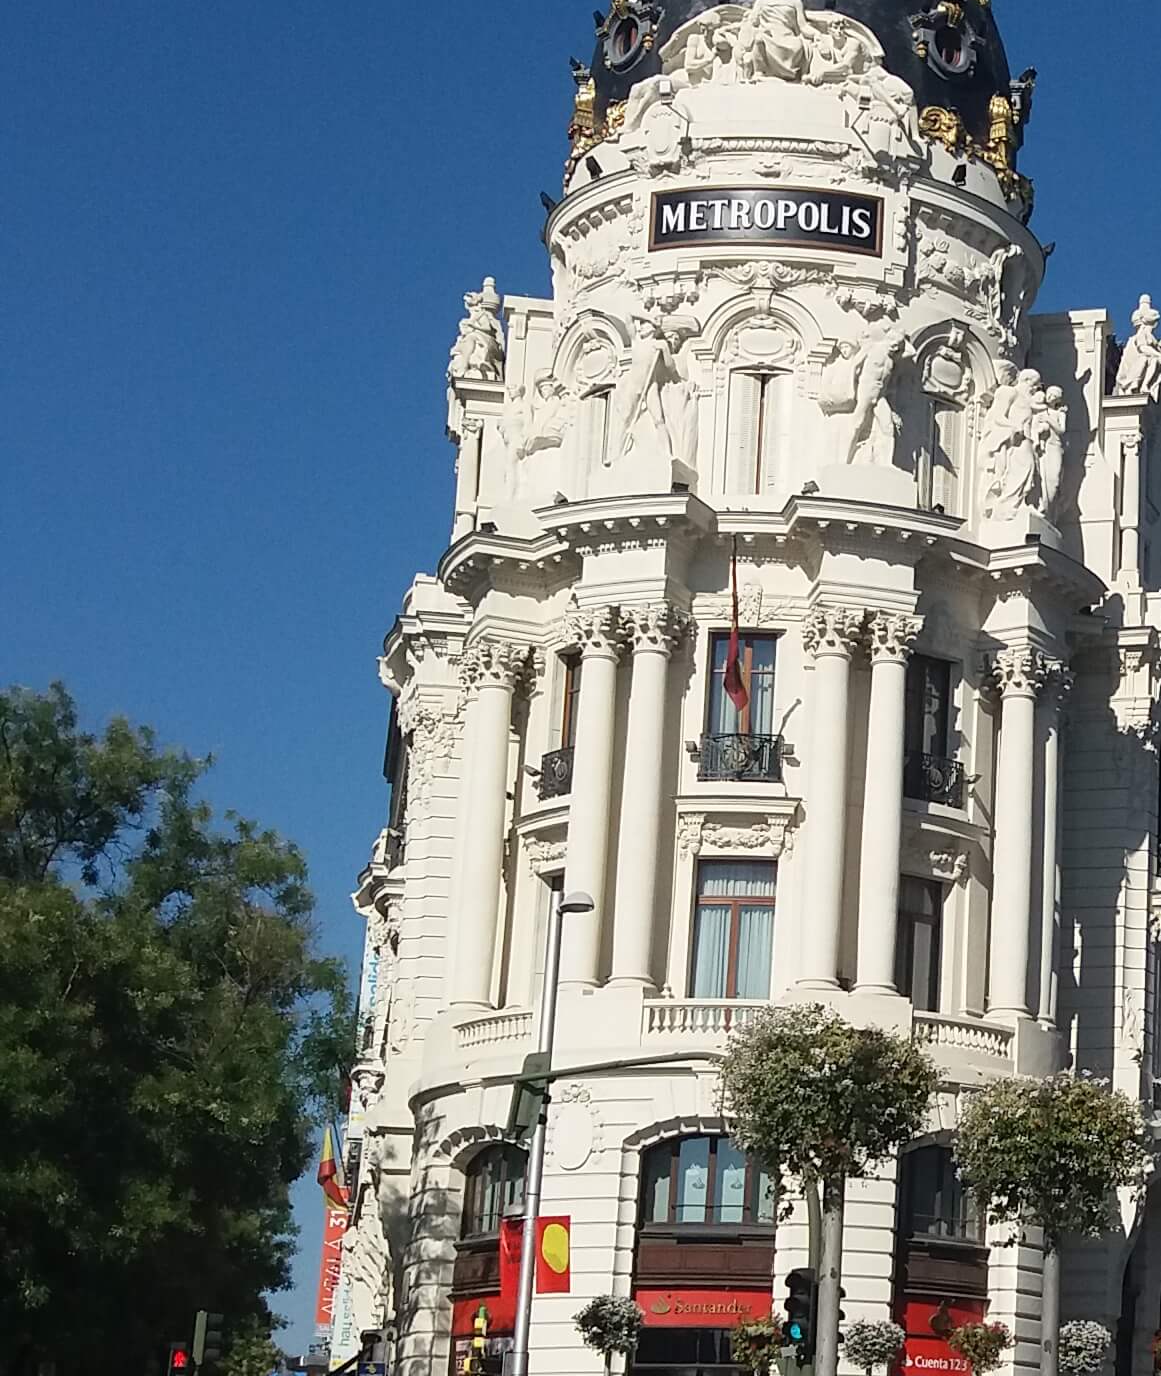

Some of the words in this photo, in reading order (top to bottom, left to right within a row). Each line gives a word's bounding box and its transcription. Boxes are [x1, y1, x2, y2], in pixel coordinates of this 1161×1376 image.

[661, 199, 871, 239] METROPOLIS
[674, 1297, 752, 1314] Santander
[914, 1356, 948, 1370] Cuenta
[948, 1358, 968, 1372] 123
